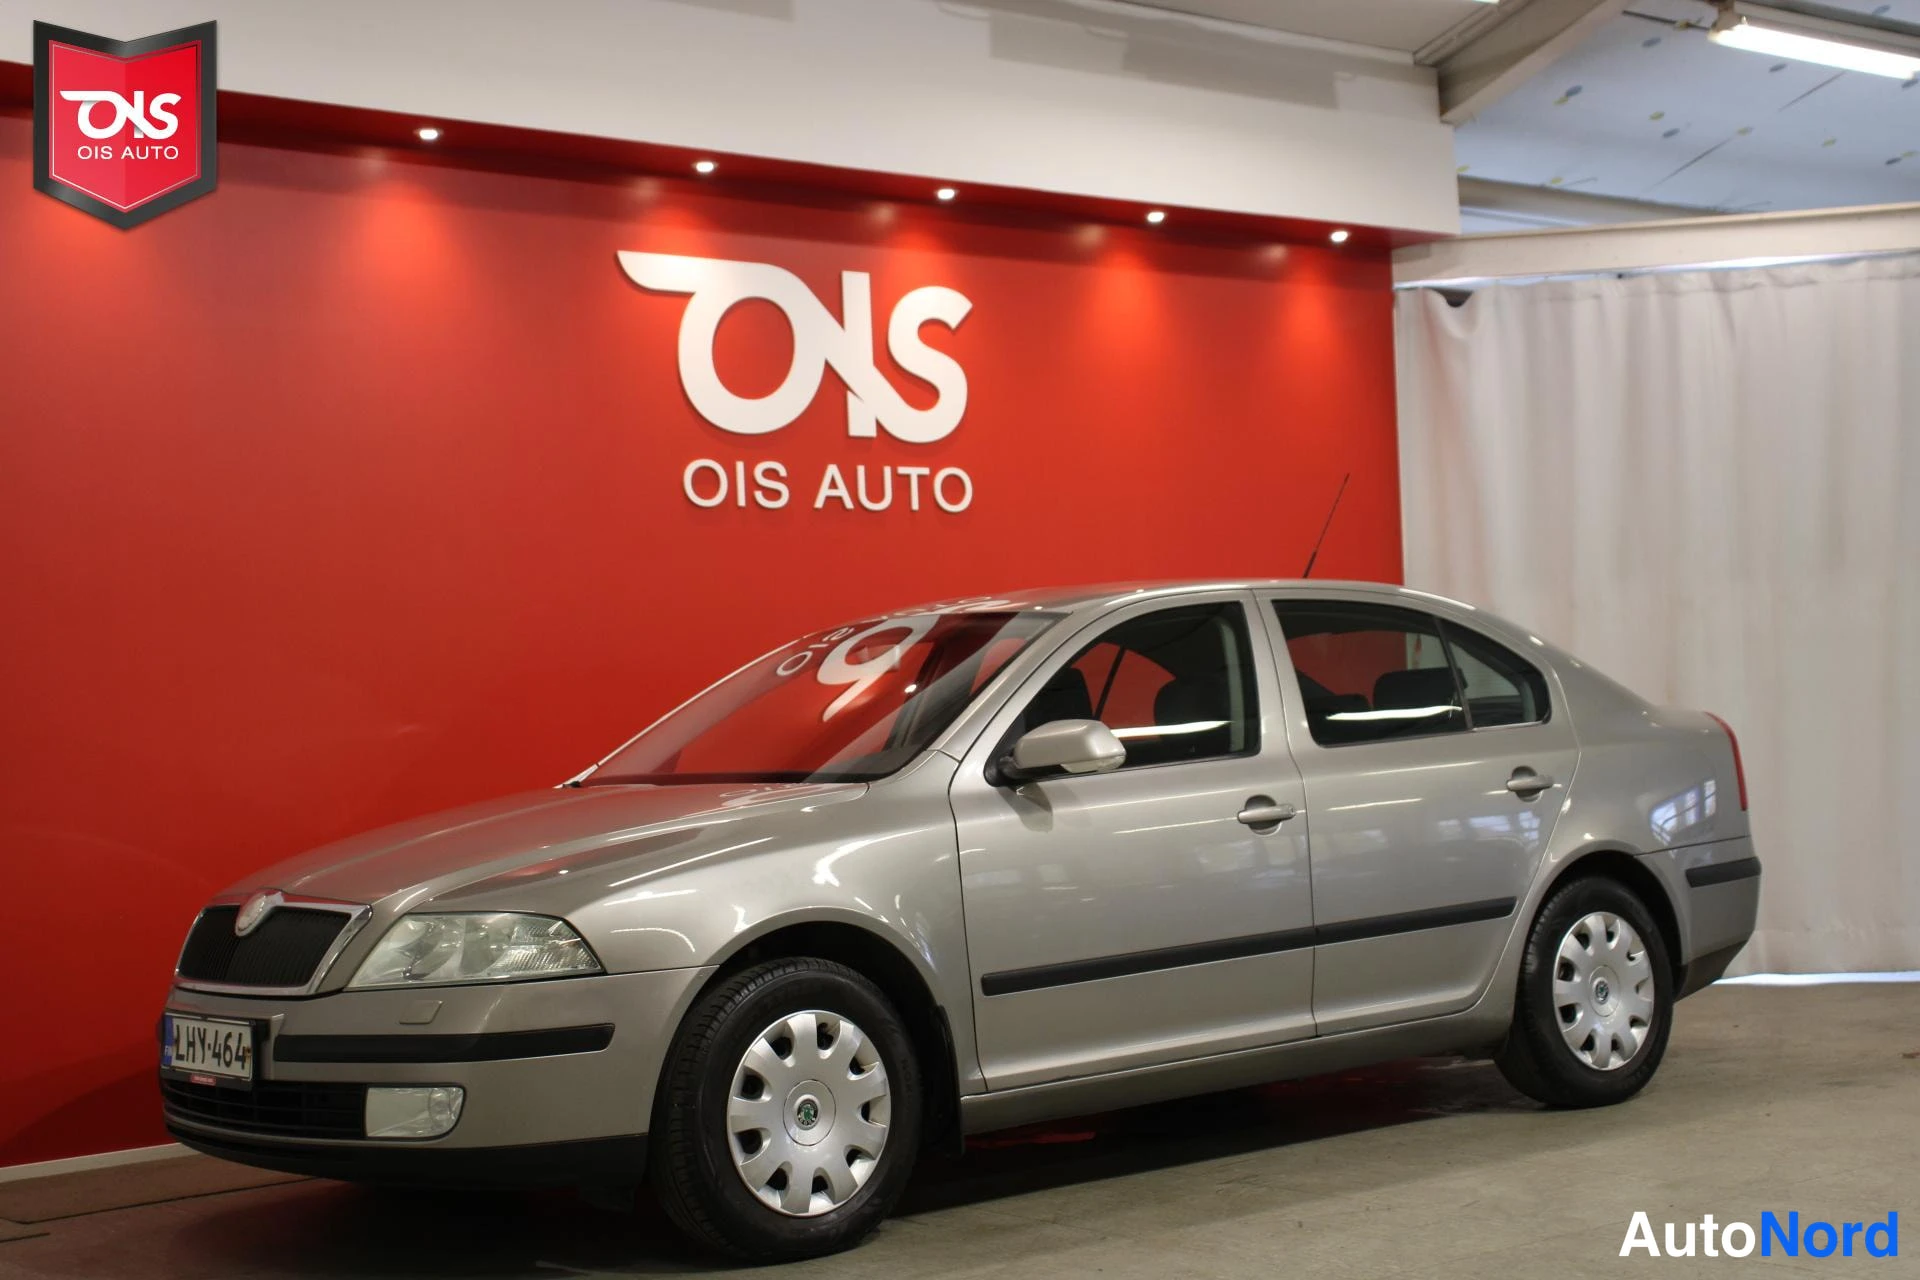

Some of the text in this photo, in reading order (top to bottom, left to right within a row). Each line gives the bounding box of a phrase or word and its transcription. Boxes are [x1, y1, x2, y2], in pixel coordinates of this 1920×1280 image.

[683, 458, 973, 513] OIS AUTO
[175, 1024, 247, 1070] LHY-464
